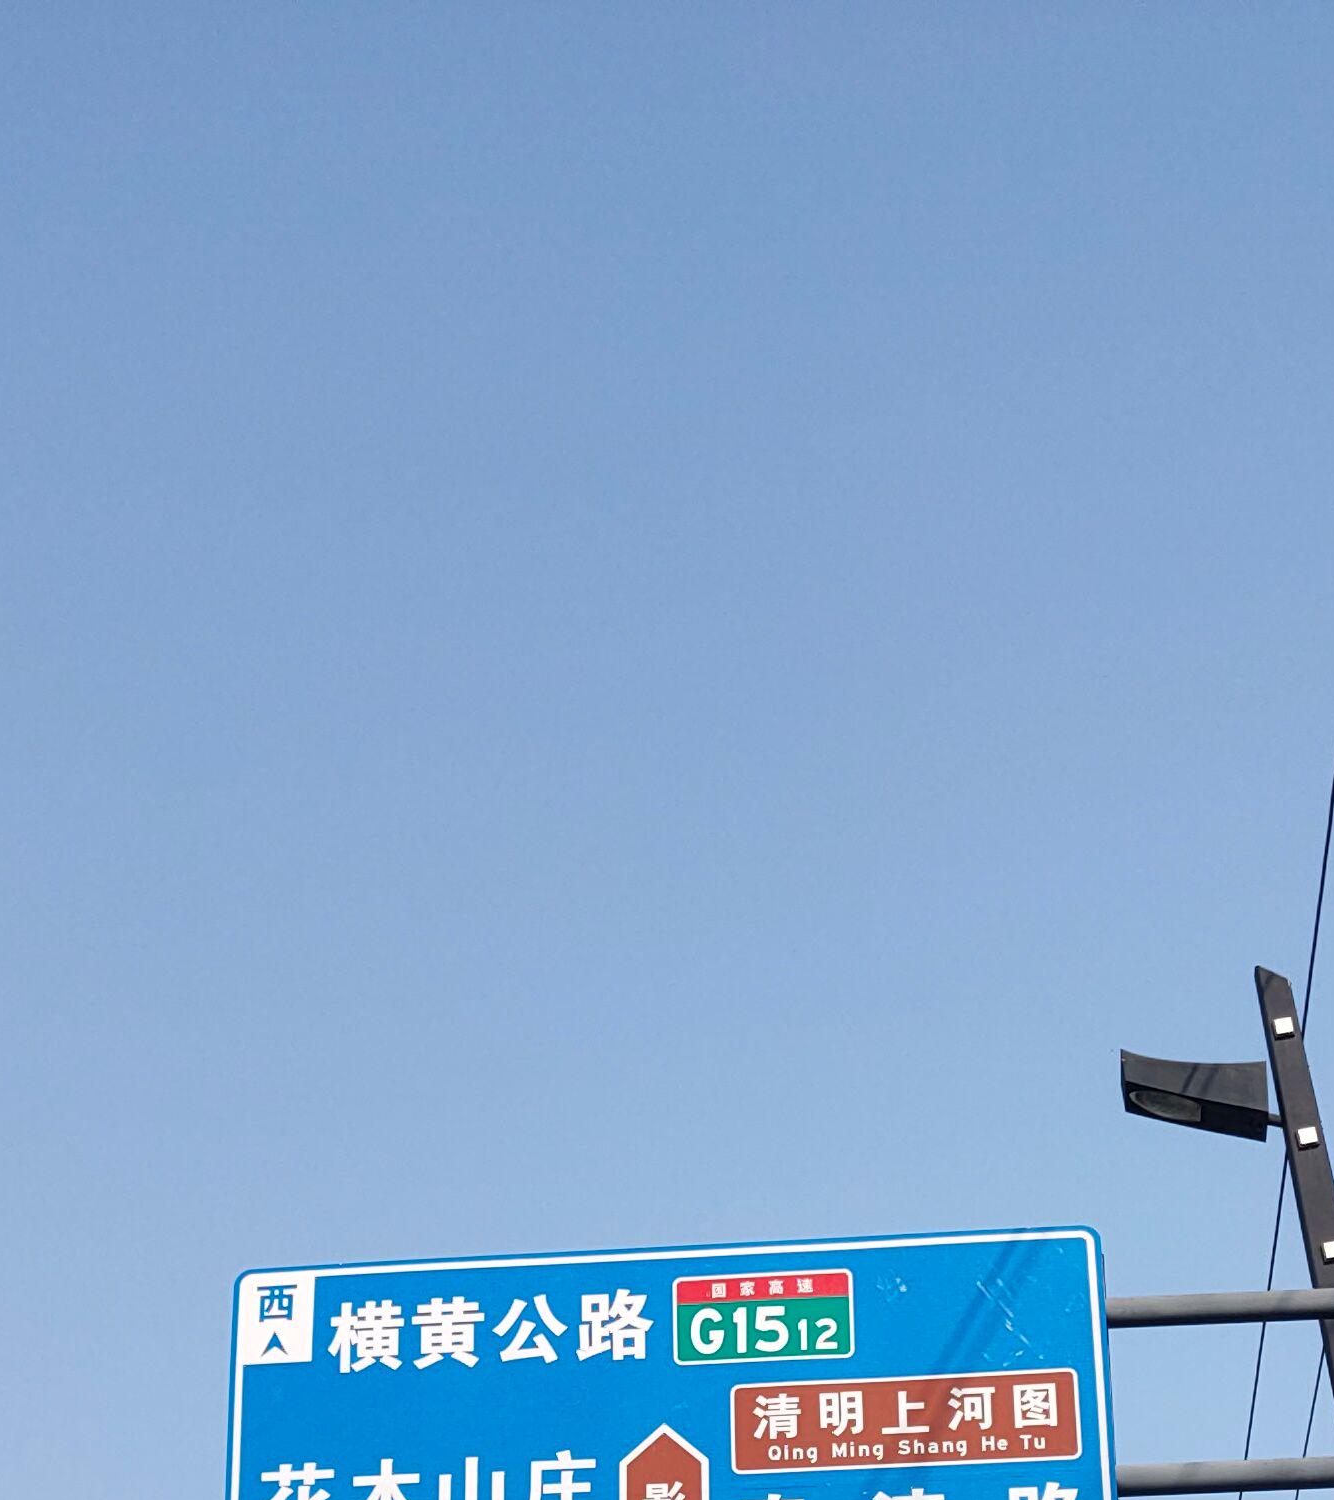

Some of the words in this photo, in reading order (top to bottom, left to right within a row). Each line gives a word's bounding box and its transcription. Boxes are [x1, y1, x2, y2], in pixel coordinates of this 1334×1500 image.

[257, 1284, 298, 1323] 西
[711, 1278, 814, 1299] 国家高速
[328, 1288, 654, 1374] 横黄公路
[753, 1382, 1059, 1440] 清明上河图
[768, 1445, 818, 1463] Qing
[831, 1442, 884, 1460] Ming
[898, 1439, 968, 1457] Shang
[981, 1436, 1009, 1452] He
[1019, 1434, 1046, 1451] Tu
